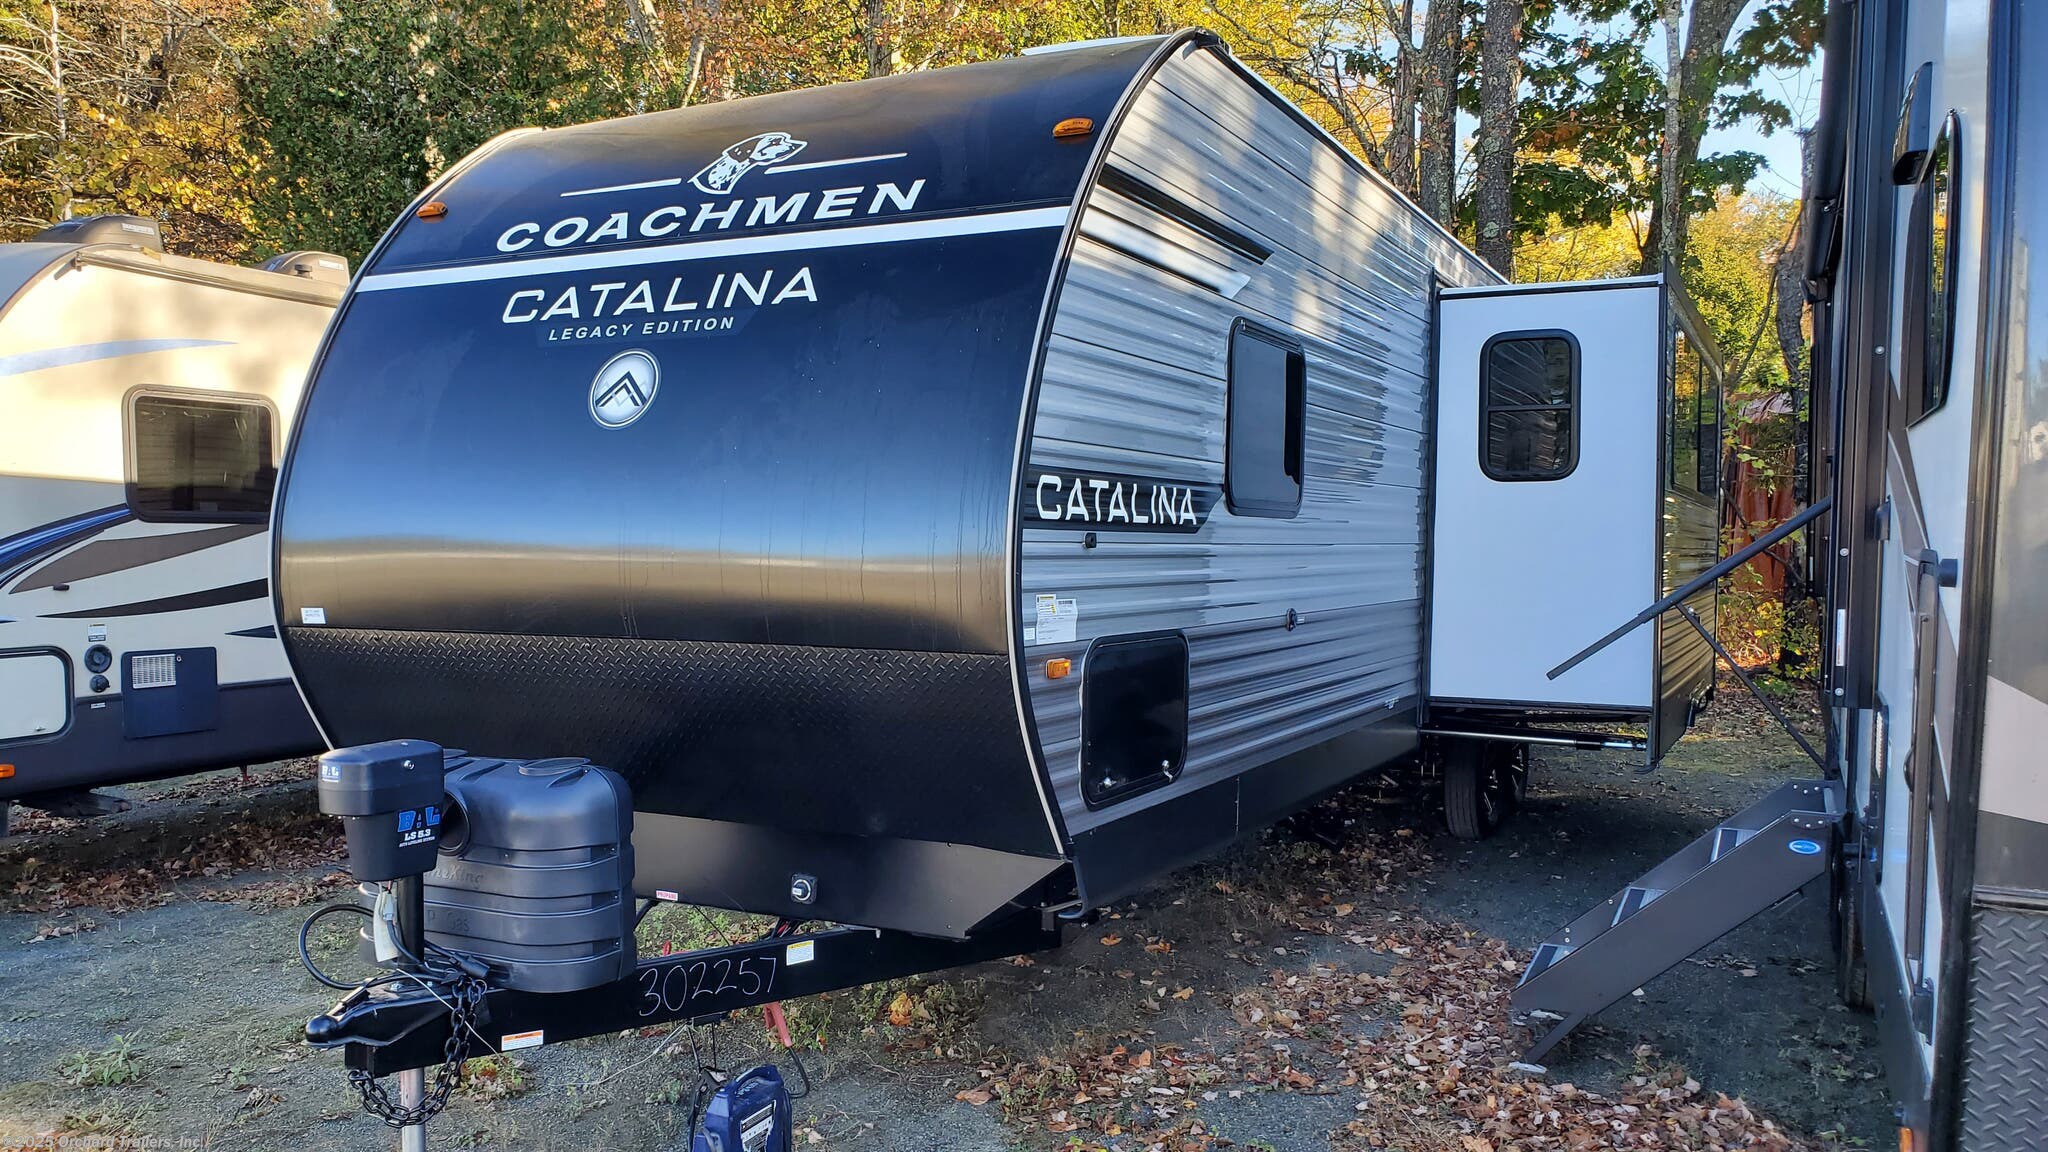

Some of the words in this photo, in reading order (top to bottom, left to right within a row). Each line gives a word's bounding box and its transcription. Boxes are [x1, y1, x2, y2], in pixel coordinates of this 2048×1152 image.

[496, 179, 926, 253] COACHMEN
[502, 267, 818, 324] CATALINA
[548, 323, 633, 341] LEGACY
[642, 316, 734, 335] EDITION
[1036, 474, 1197, 525] CATALINA
[639, 957, 777, 1016] 302257
